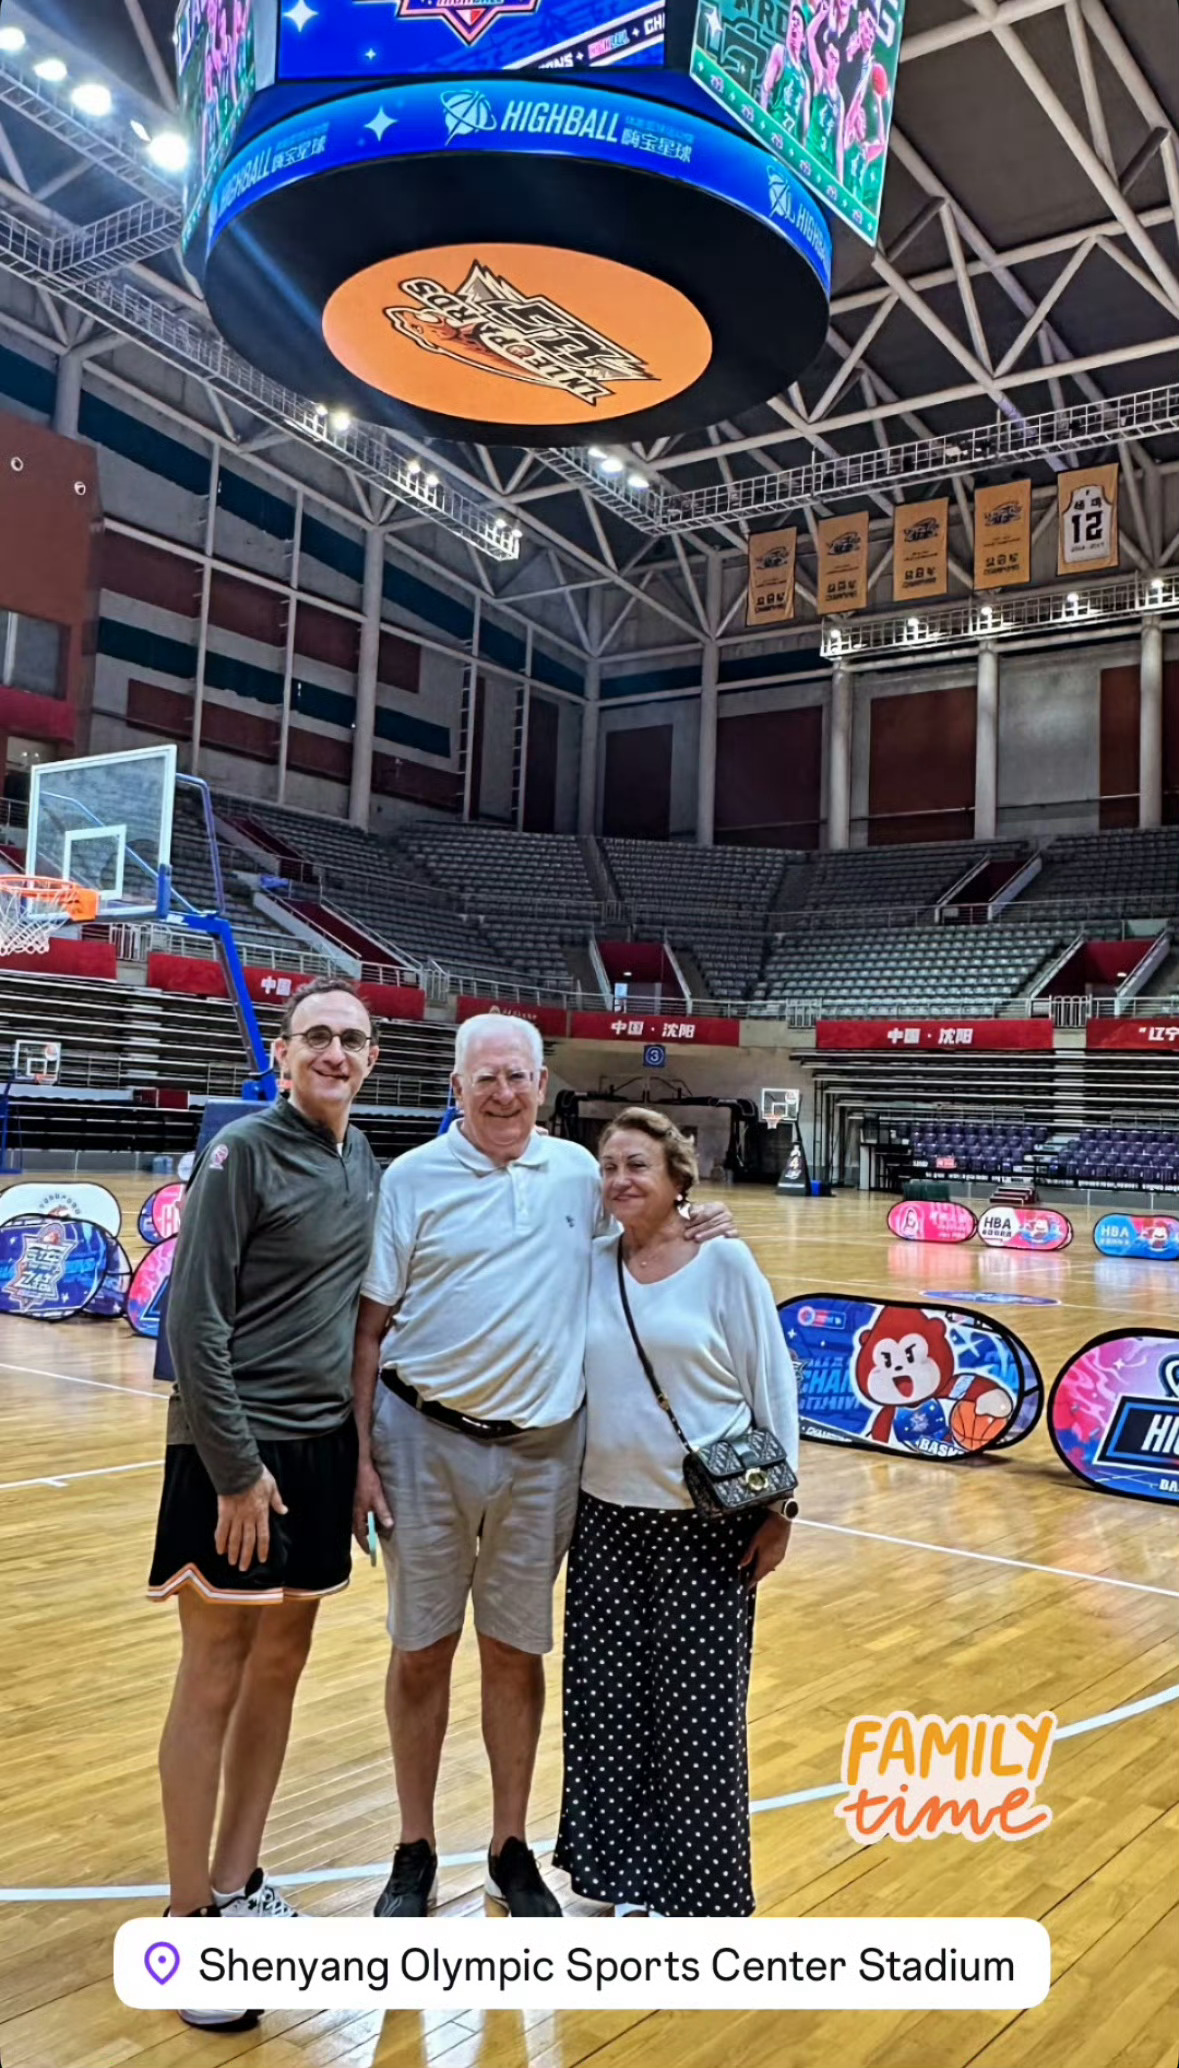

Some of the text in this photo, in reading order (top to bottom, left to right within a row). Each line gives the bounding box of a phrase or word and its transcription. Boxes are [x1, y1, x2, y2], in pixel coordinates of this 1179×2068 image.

[500, 100, 619, 143] HIGHBALL
[1071, 510, 1103, 543] 12
[984, 1216, 1011, 1229] HBA
[1101, 1225, 1129, 1238] HBA
